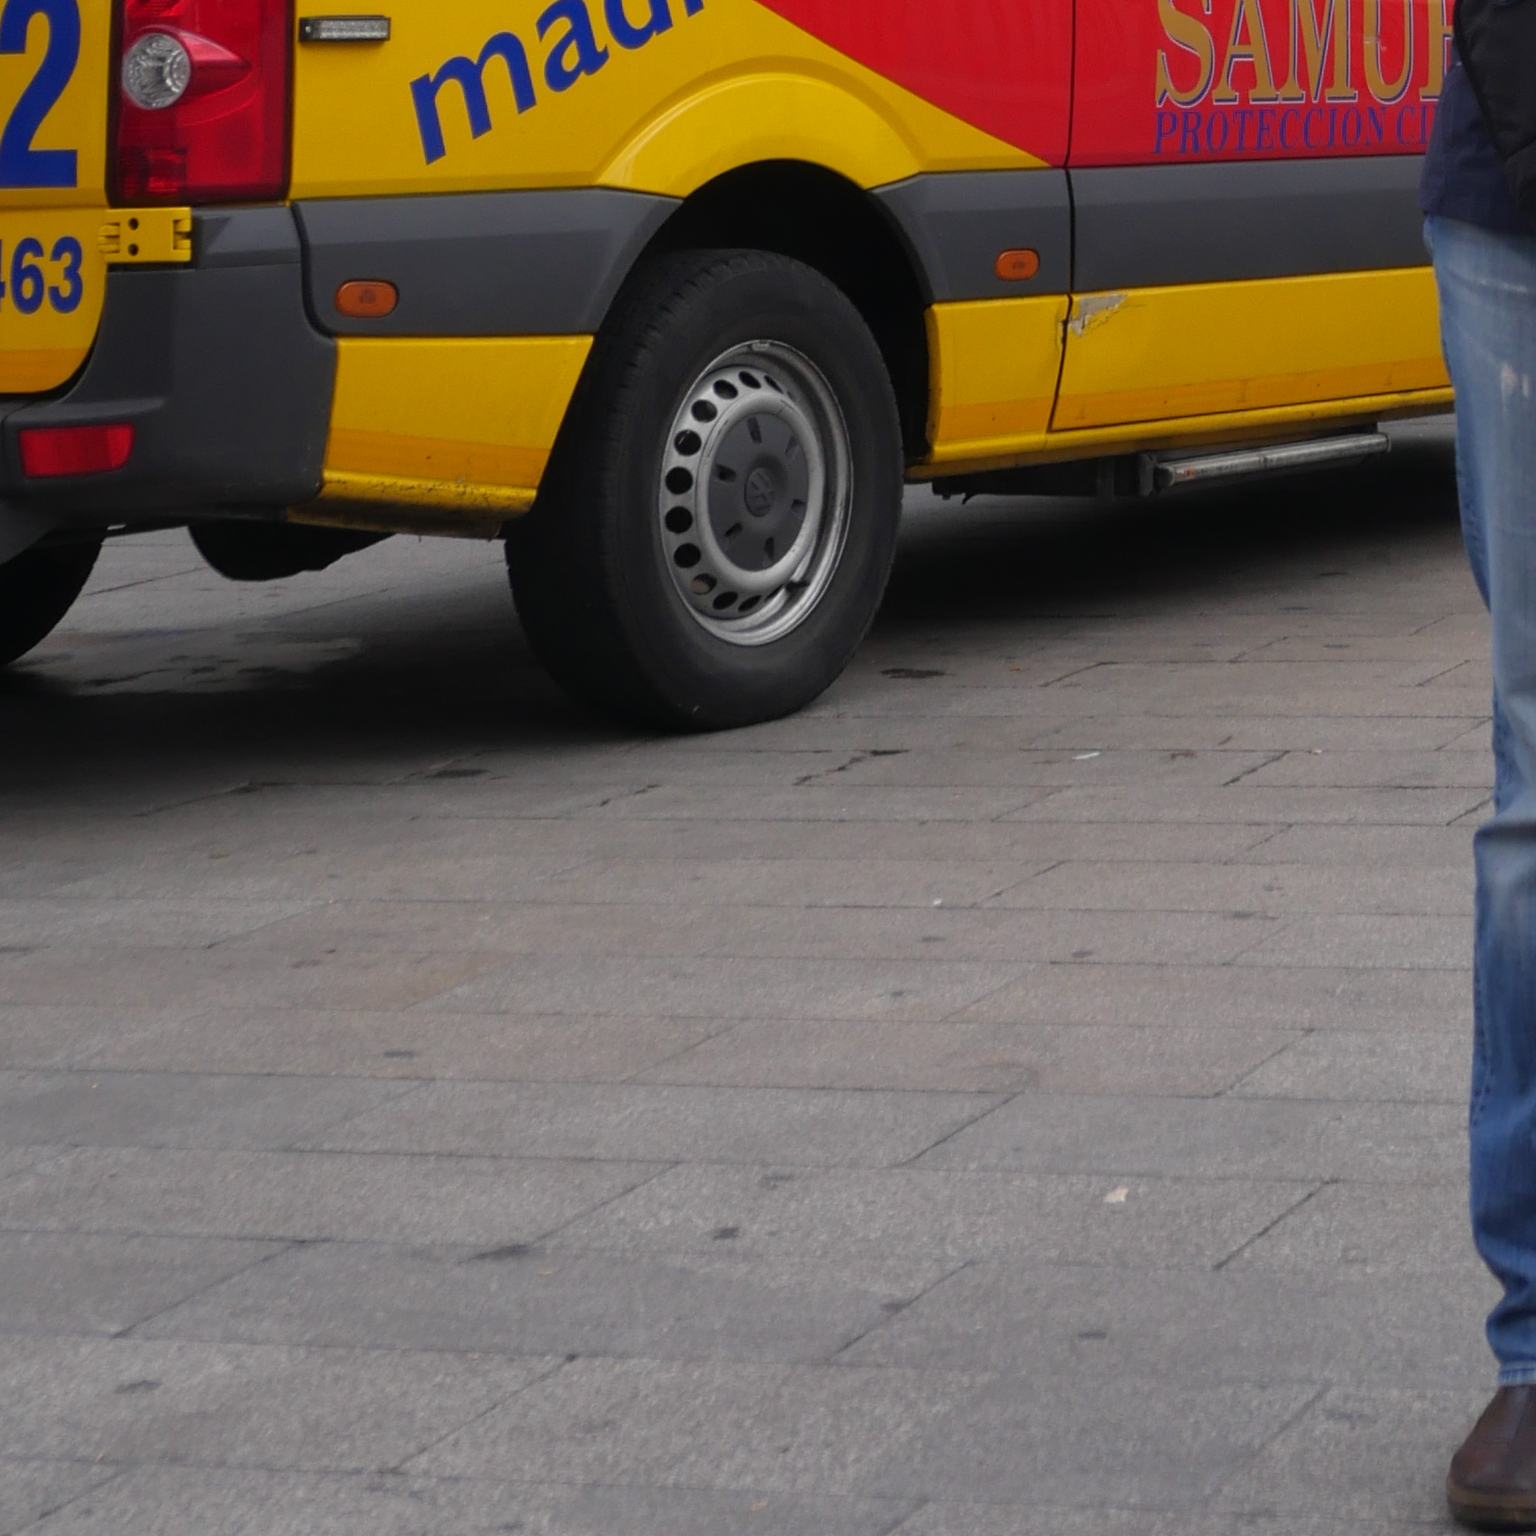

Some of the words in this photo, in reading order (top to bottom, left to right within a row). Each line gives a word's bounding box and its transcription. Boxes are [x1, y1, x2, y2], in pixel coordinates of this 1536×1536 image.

[1153, 105, 1387, 155] PROTECCION
[1395, 104, 1438, 146] CI
[0, 234, 84, 315] 63
